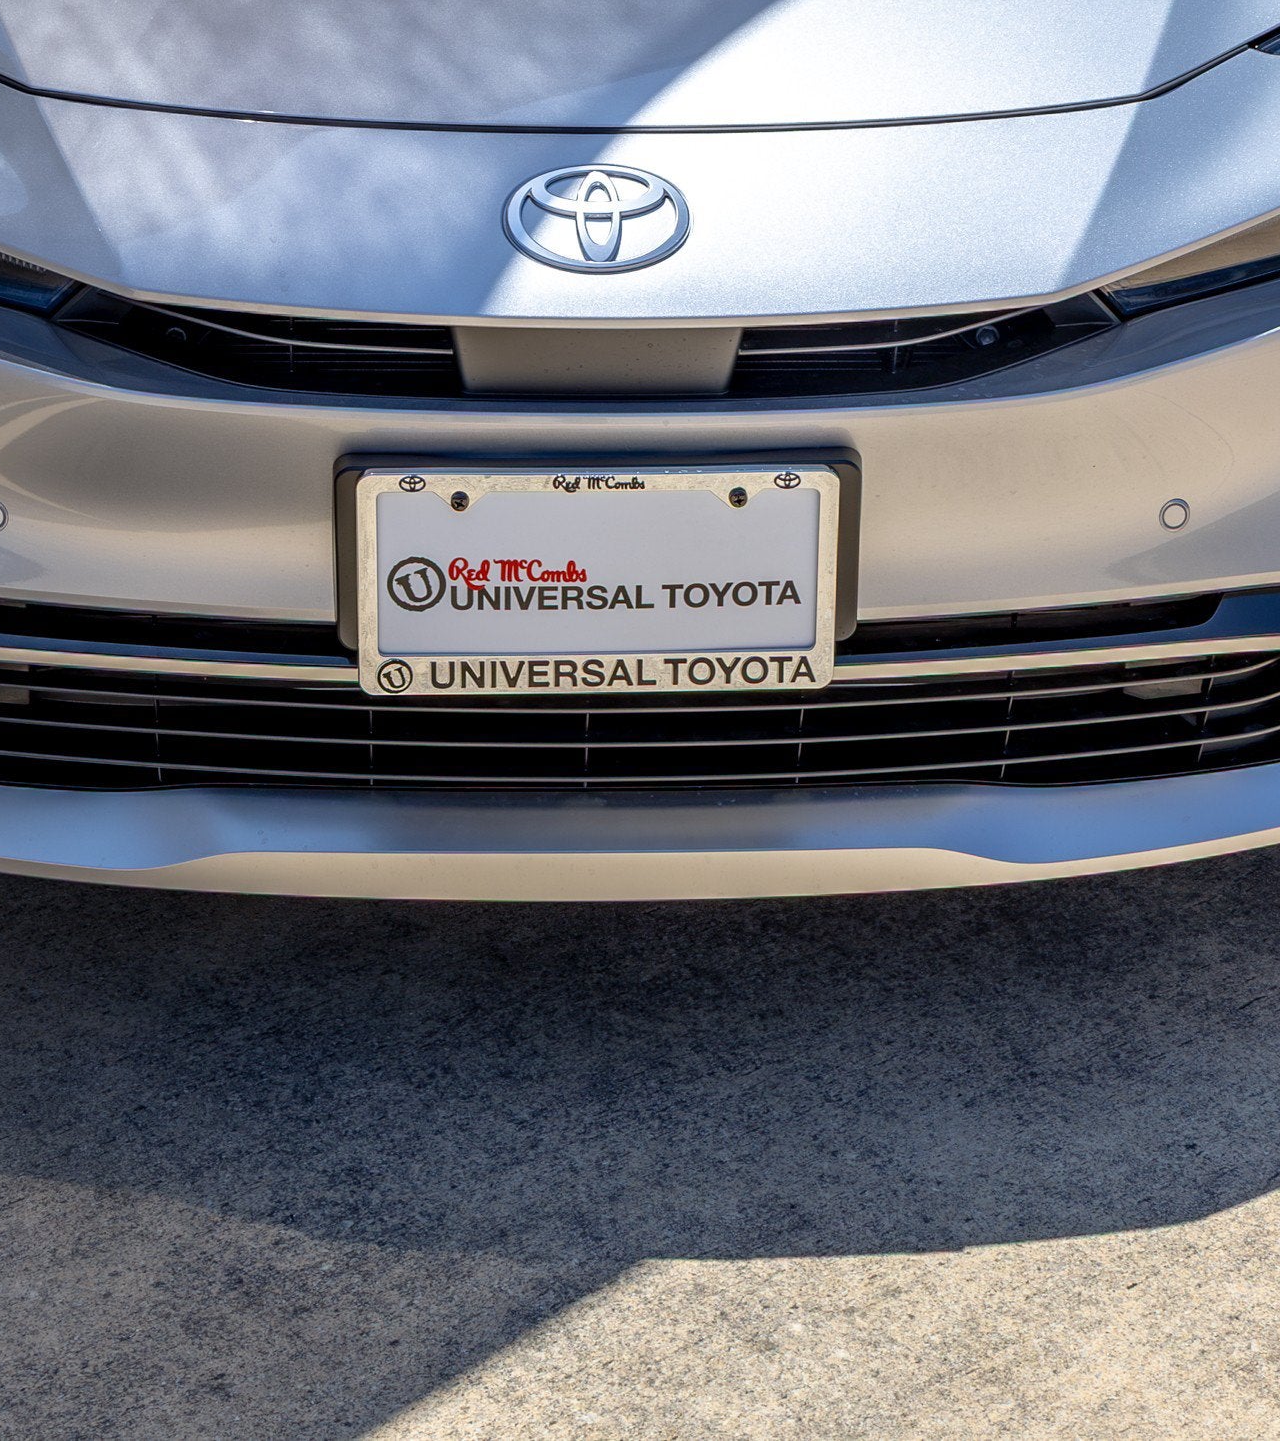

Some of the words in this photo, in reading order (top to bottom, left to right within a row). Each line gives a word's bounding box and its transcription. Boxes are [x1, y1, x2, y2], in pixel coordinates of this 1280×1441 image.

[552, 474, 581, 493] Red
[582, 475, 645, 490] McCombs
[448, 557, 491, 590] Red
[493, 559, 587, 582] McCombs
[450, 585, 655, 611] UNIVERSAL
[661, 580, 802, 609] TOYOTA
[430, 659, 657, 689] UNIVERSAL
[663, 656, 816, 685] TOYOTA
